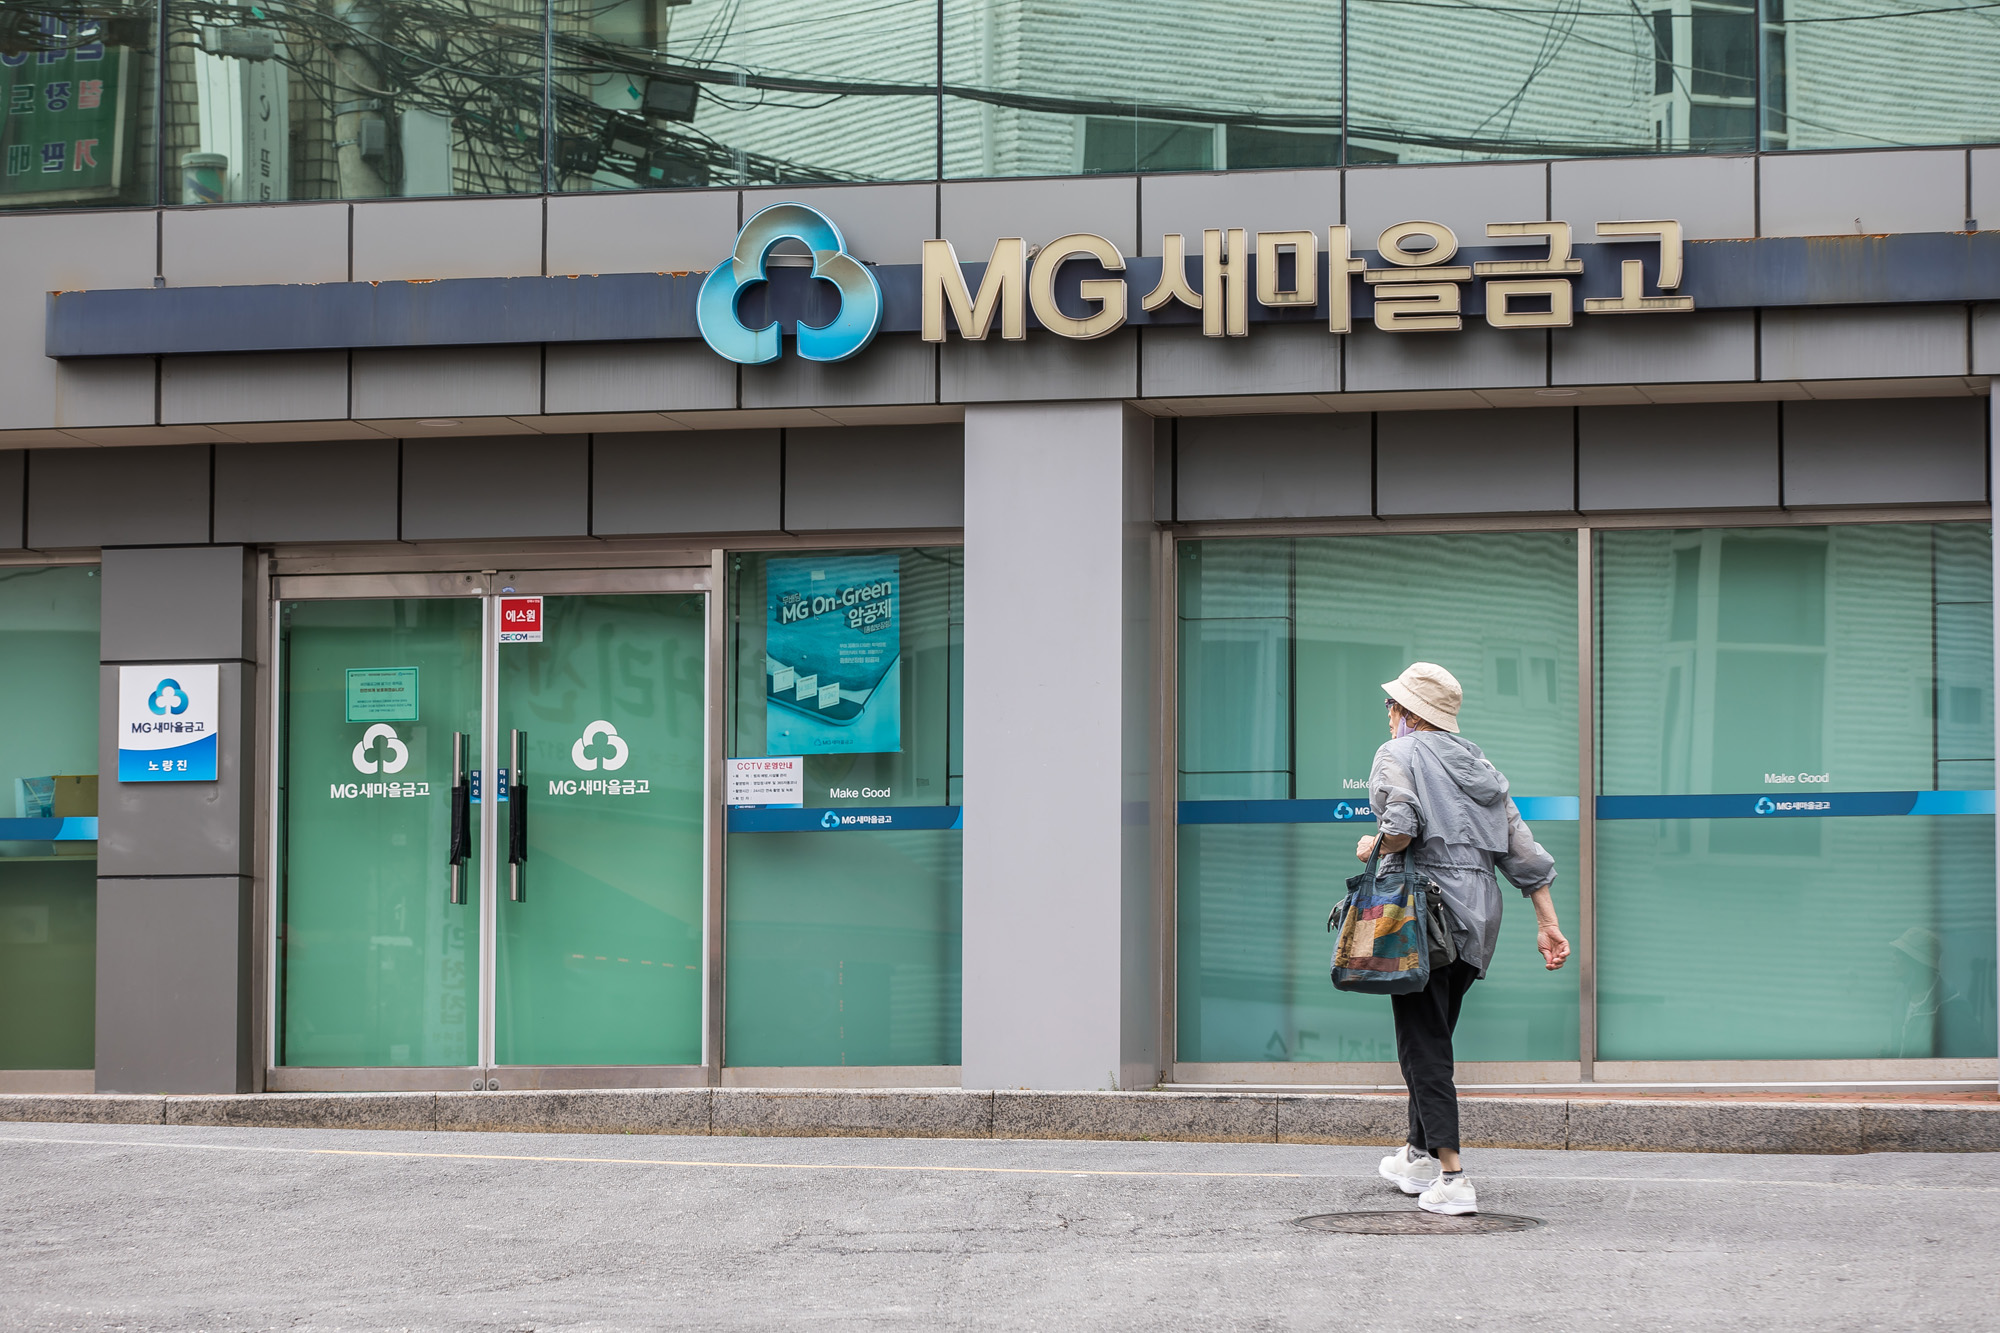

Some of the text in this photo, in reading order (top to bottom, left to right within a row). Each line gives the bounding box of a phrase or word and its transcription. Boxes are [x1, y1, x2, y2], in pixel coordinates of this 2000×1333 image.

[782, 581, 892, 625] MG On-Green
[505, 609, 536, 623] 에스원
[848, 598, 892, 629] 암공제
[501, 633, 528, 641] SECOM
[736, 761, 793, 771] CCTV 운영안내
[1764, 772, 1830, 784] Make Good
[830, 787, 891, 799] Make Good
